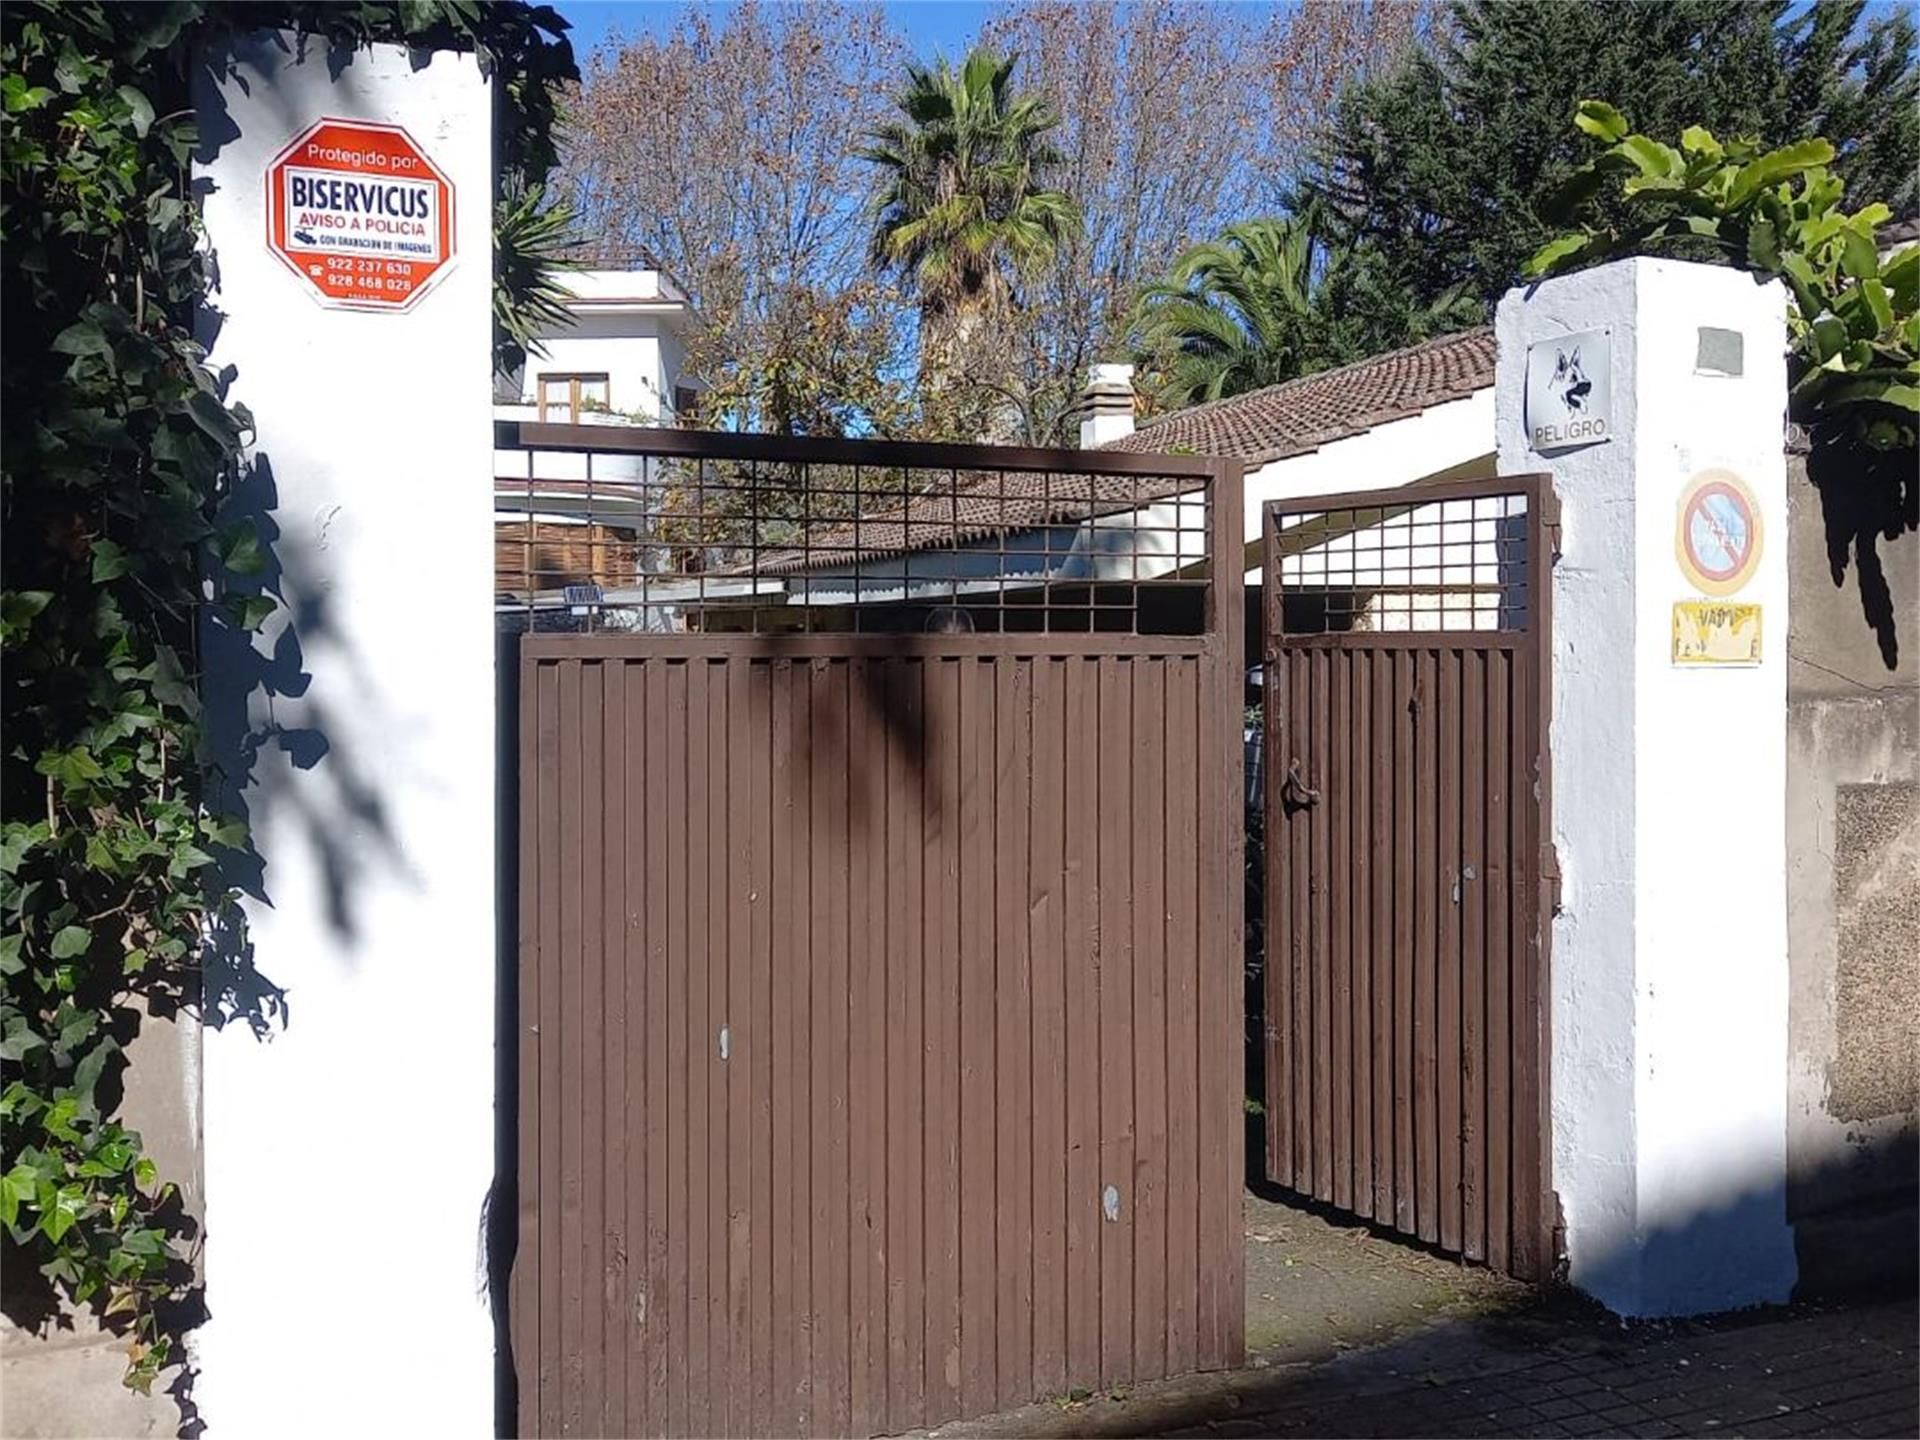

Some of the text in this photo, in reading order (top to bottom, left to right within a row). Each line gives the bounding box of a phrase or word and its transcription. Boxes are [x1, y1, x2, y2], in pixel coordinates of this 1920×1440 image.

[308, 144, 418, 170] Protegido por
[292, 177, 429, 219] BISERVICUS
[300, 212, 425, 236] AVISO A POLICIA
[320, 234, 336, 245] CON
[383, 241, 392, 250] DE
[327, 258, 411, 275] 922 237 630
[327, 274, 353, 287] 928
[1535, 419, 1605, 443] PELIGRO
